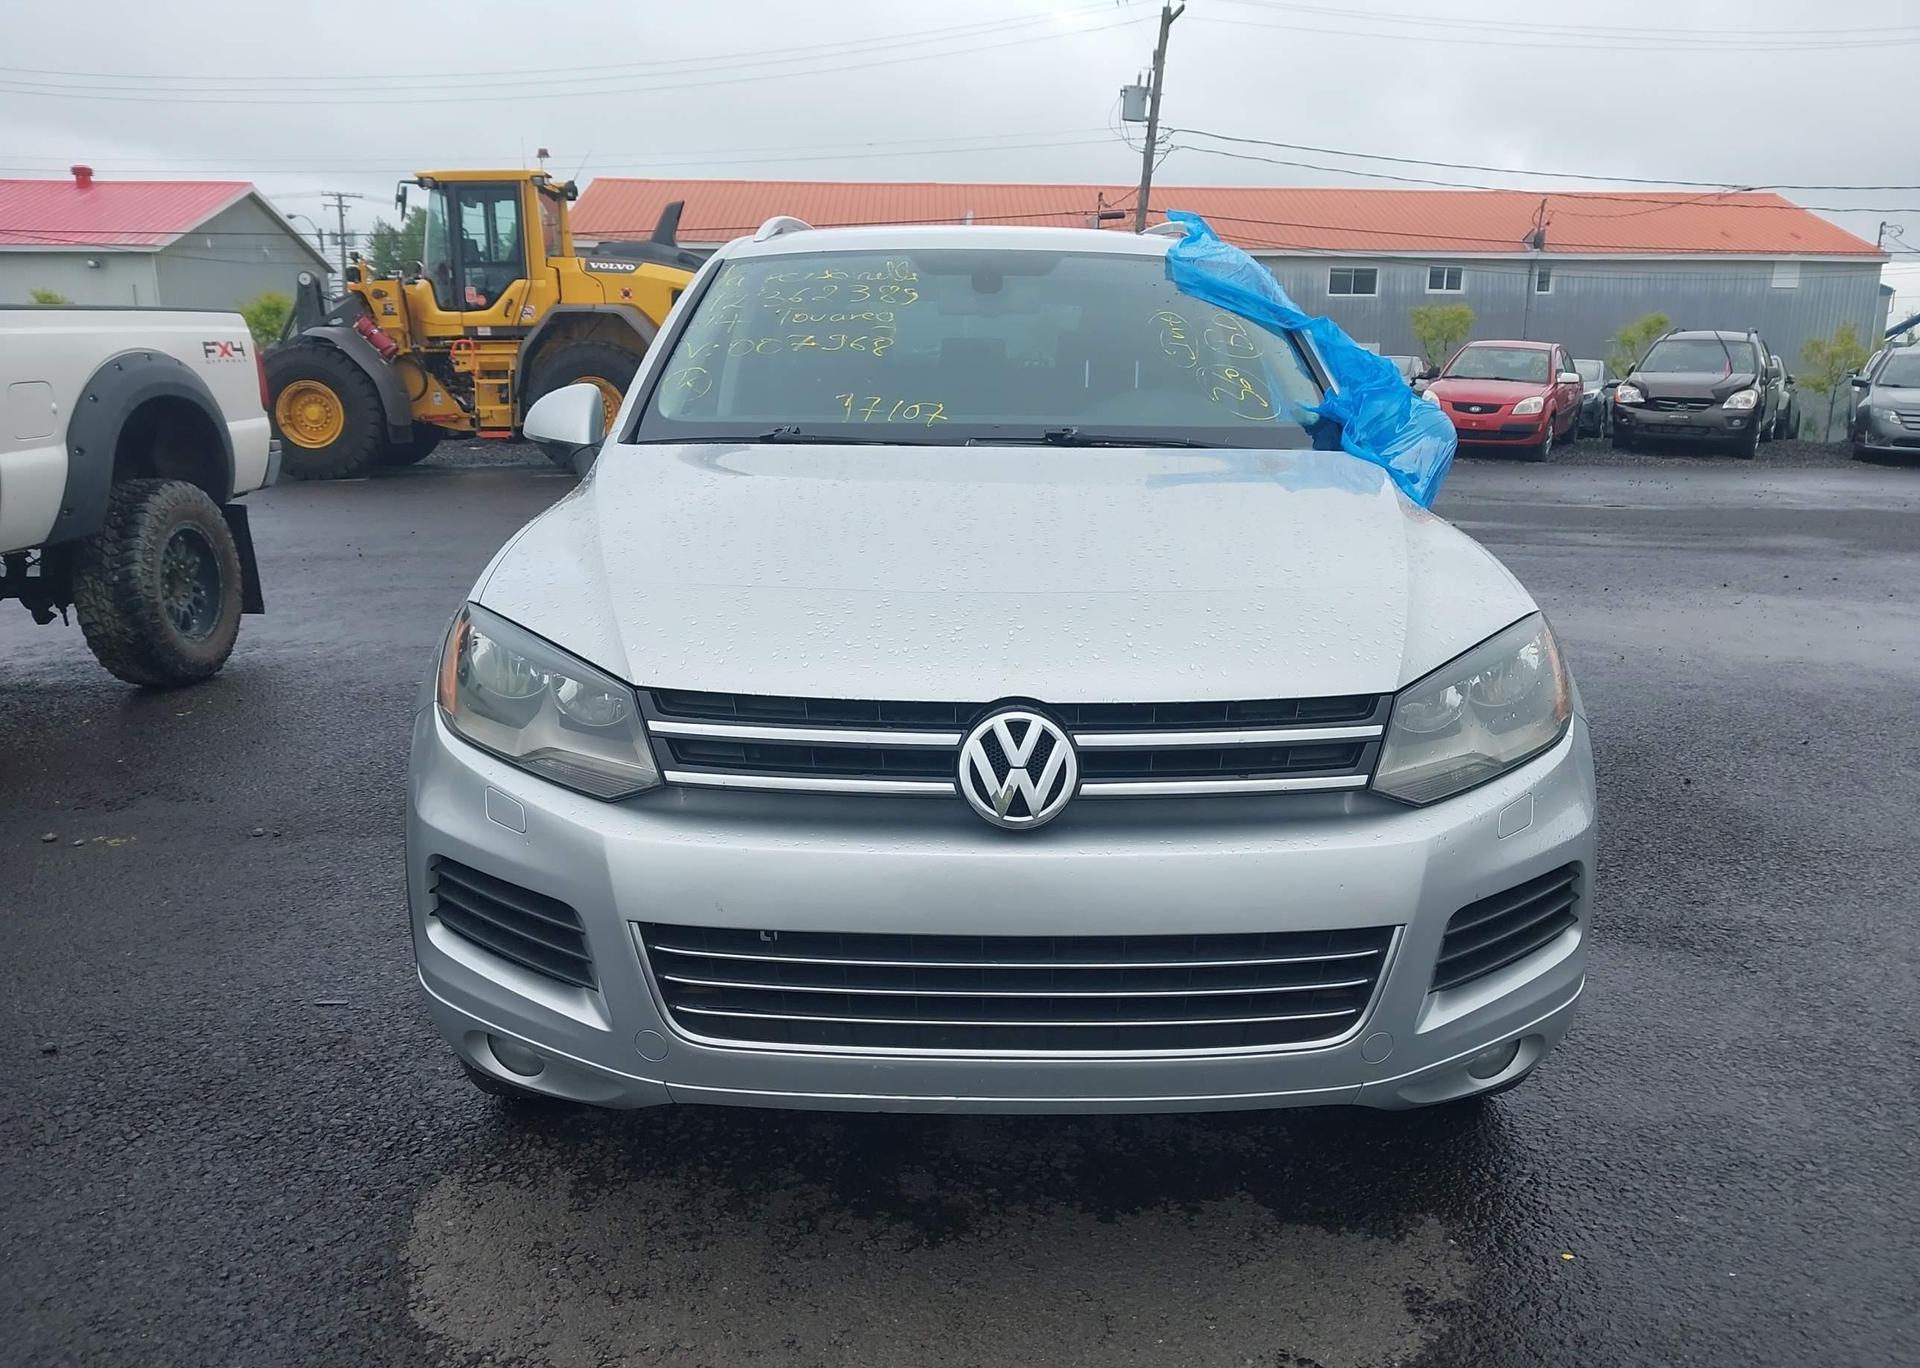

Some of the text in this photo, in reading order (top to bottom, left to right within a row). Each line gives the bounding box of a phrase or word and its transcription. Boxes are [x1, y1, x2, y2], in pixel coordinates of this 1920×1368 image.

[589, 262, 636, 271] VOLVO
[201, 341, 246, 358] FX4
[960, 711, 1077, 829] VW
